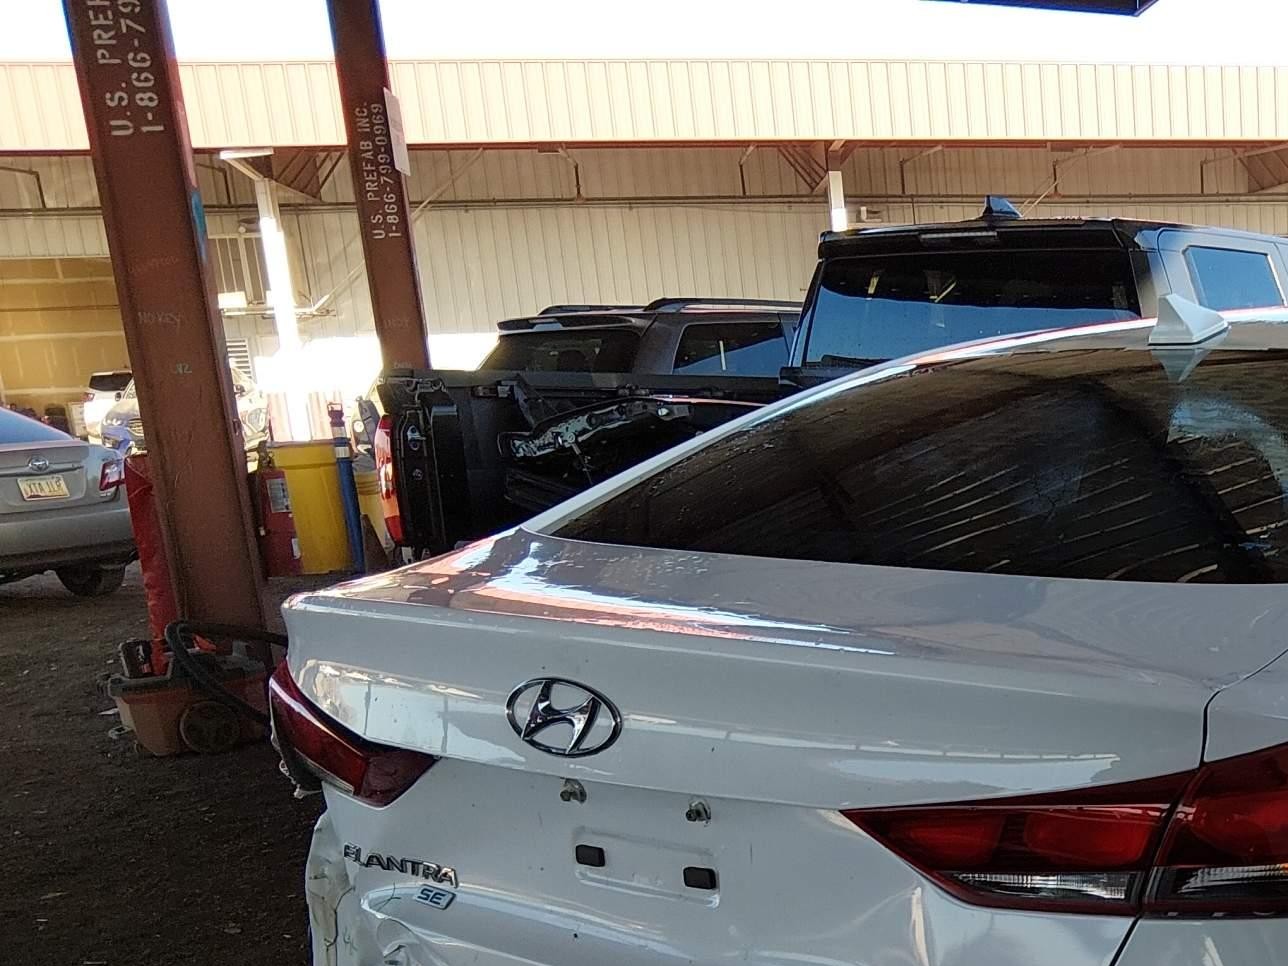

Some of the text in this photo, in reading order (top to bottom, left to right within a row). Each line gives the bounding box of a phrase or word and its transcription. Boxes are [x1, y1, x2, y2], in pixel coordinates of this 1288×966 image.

[105, 82, 134, 136] U.S.
[355, 102, 385, 239] U.S. PREFAB INC.
[371, 103, 402, 238] 1-866-799-0969
[344, 842, 459, 889] ELANTRA
[417, 887, 446, 906] SE
